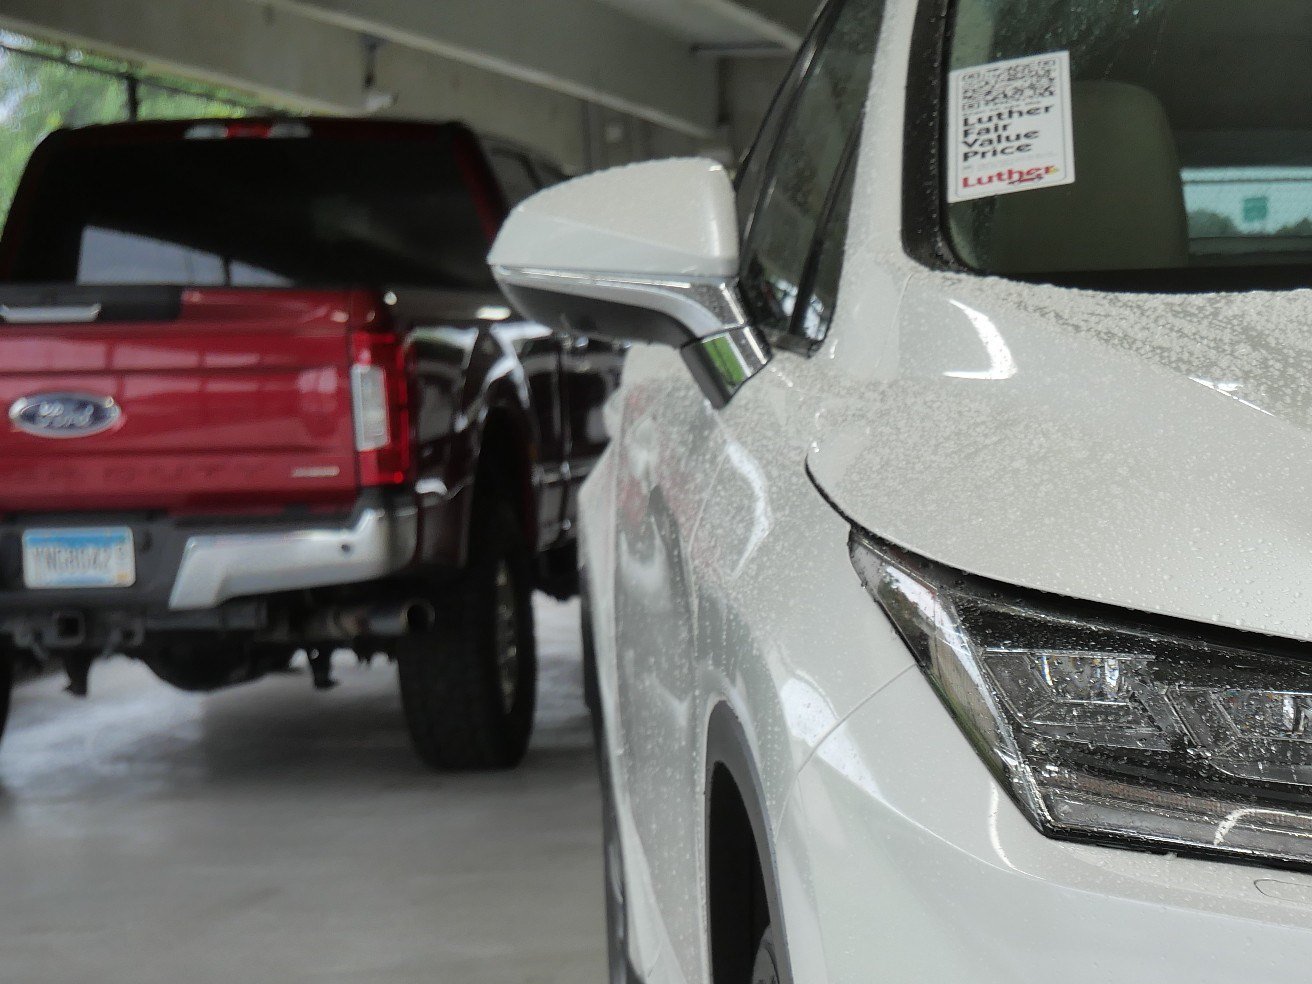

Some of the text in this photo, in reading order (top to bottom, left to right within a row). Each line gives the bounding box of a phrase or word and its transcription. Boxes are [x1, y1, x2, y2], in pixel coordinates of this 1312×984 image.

[963, 104, 1055, 127] Luther
[962, 130, 1041, 148] Value
[963, 122, 1011, 138] Fair
[963, 143, 1033, 162] Price
[962, 165, 1057, 188] Luther
